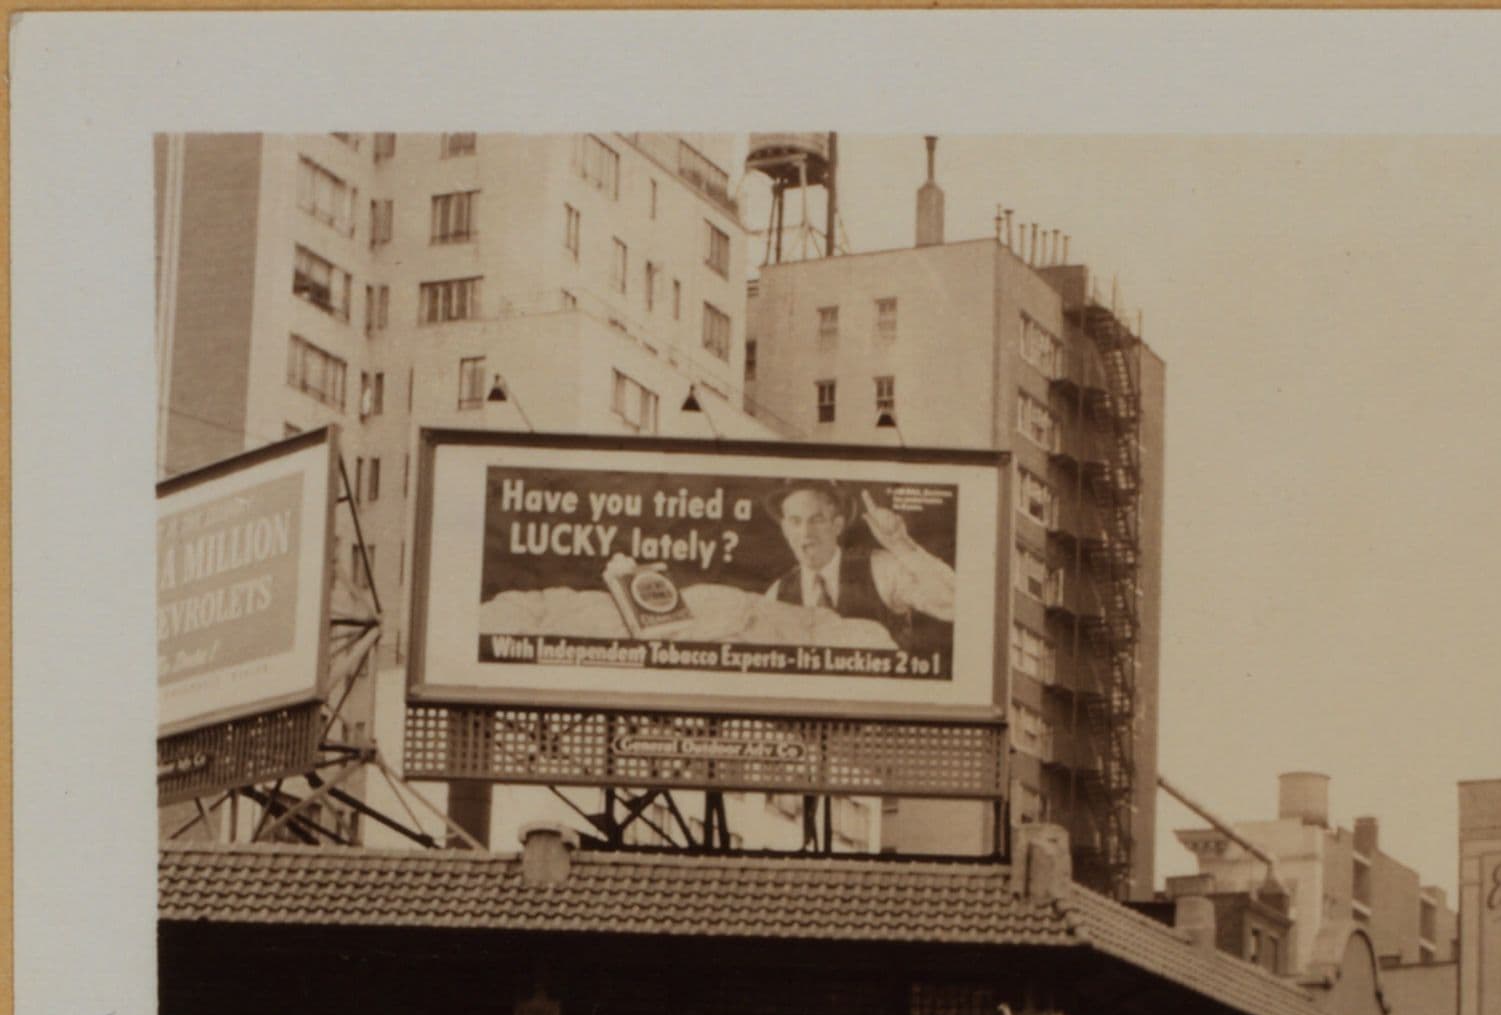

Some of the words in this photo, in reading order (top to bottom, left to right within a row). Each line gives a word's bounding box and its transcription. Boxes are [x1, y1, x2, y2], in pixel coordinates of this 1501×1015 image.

[502, 478, 578, 513] Have
[590, 493, 642, 522] you
[654, 488, 723, 518] tried
[734, 500, 752, 520] a
[184, 510, 290, 584] MILLION
[510, 522, 617, 556] LUCKY
[493, 636, 534, 659] With
[537, 637, 646, 667] Independent
[649, 641, 719, 666] Tobacco
[825, 649, 891, 672] Luckies
[896, 652, 908, 673] 2
[911, 657, 930, 672] to
